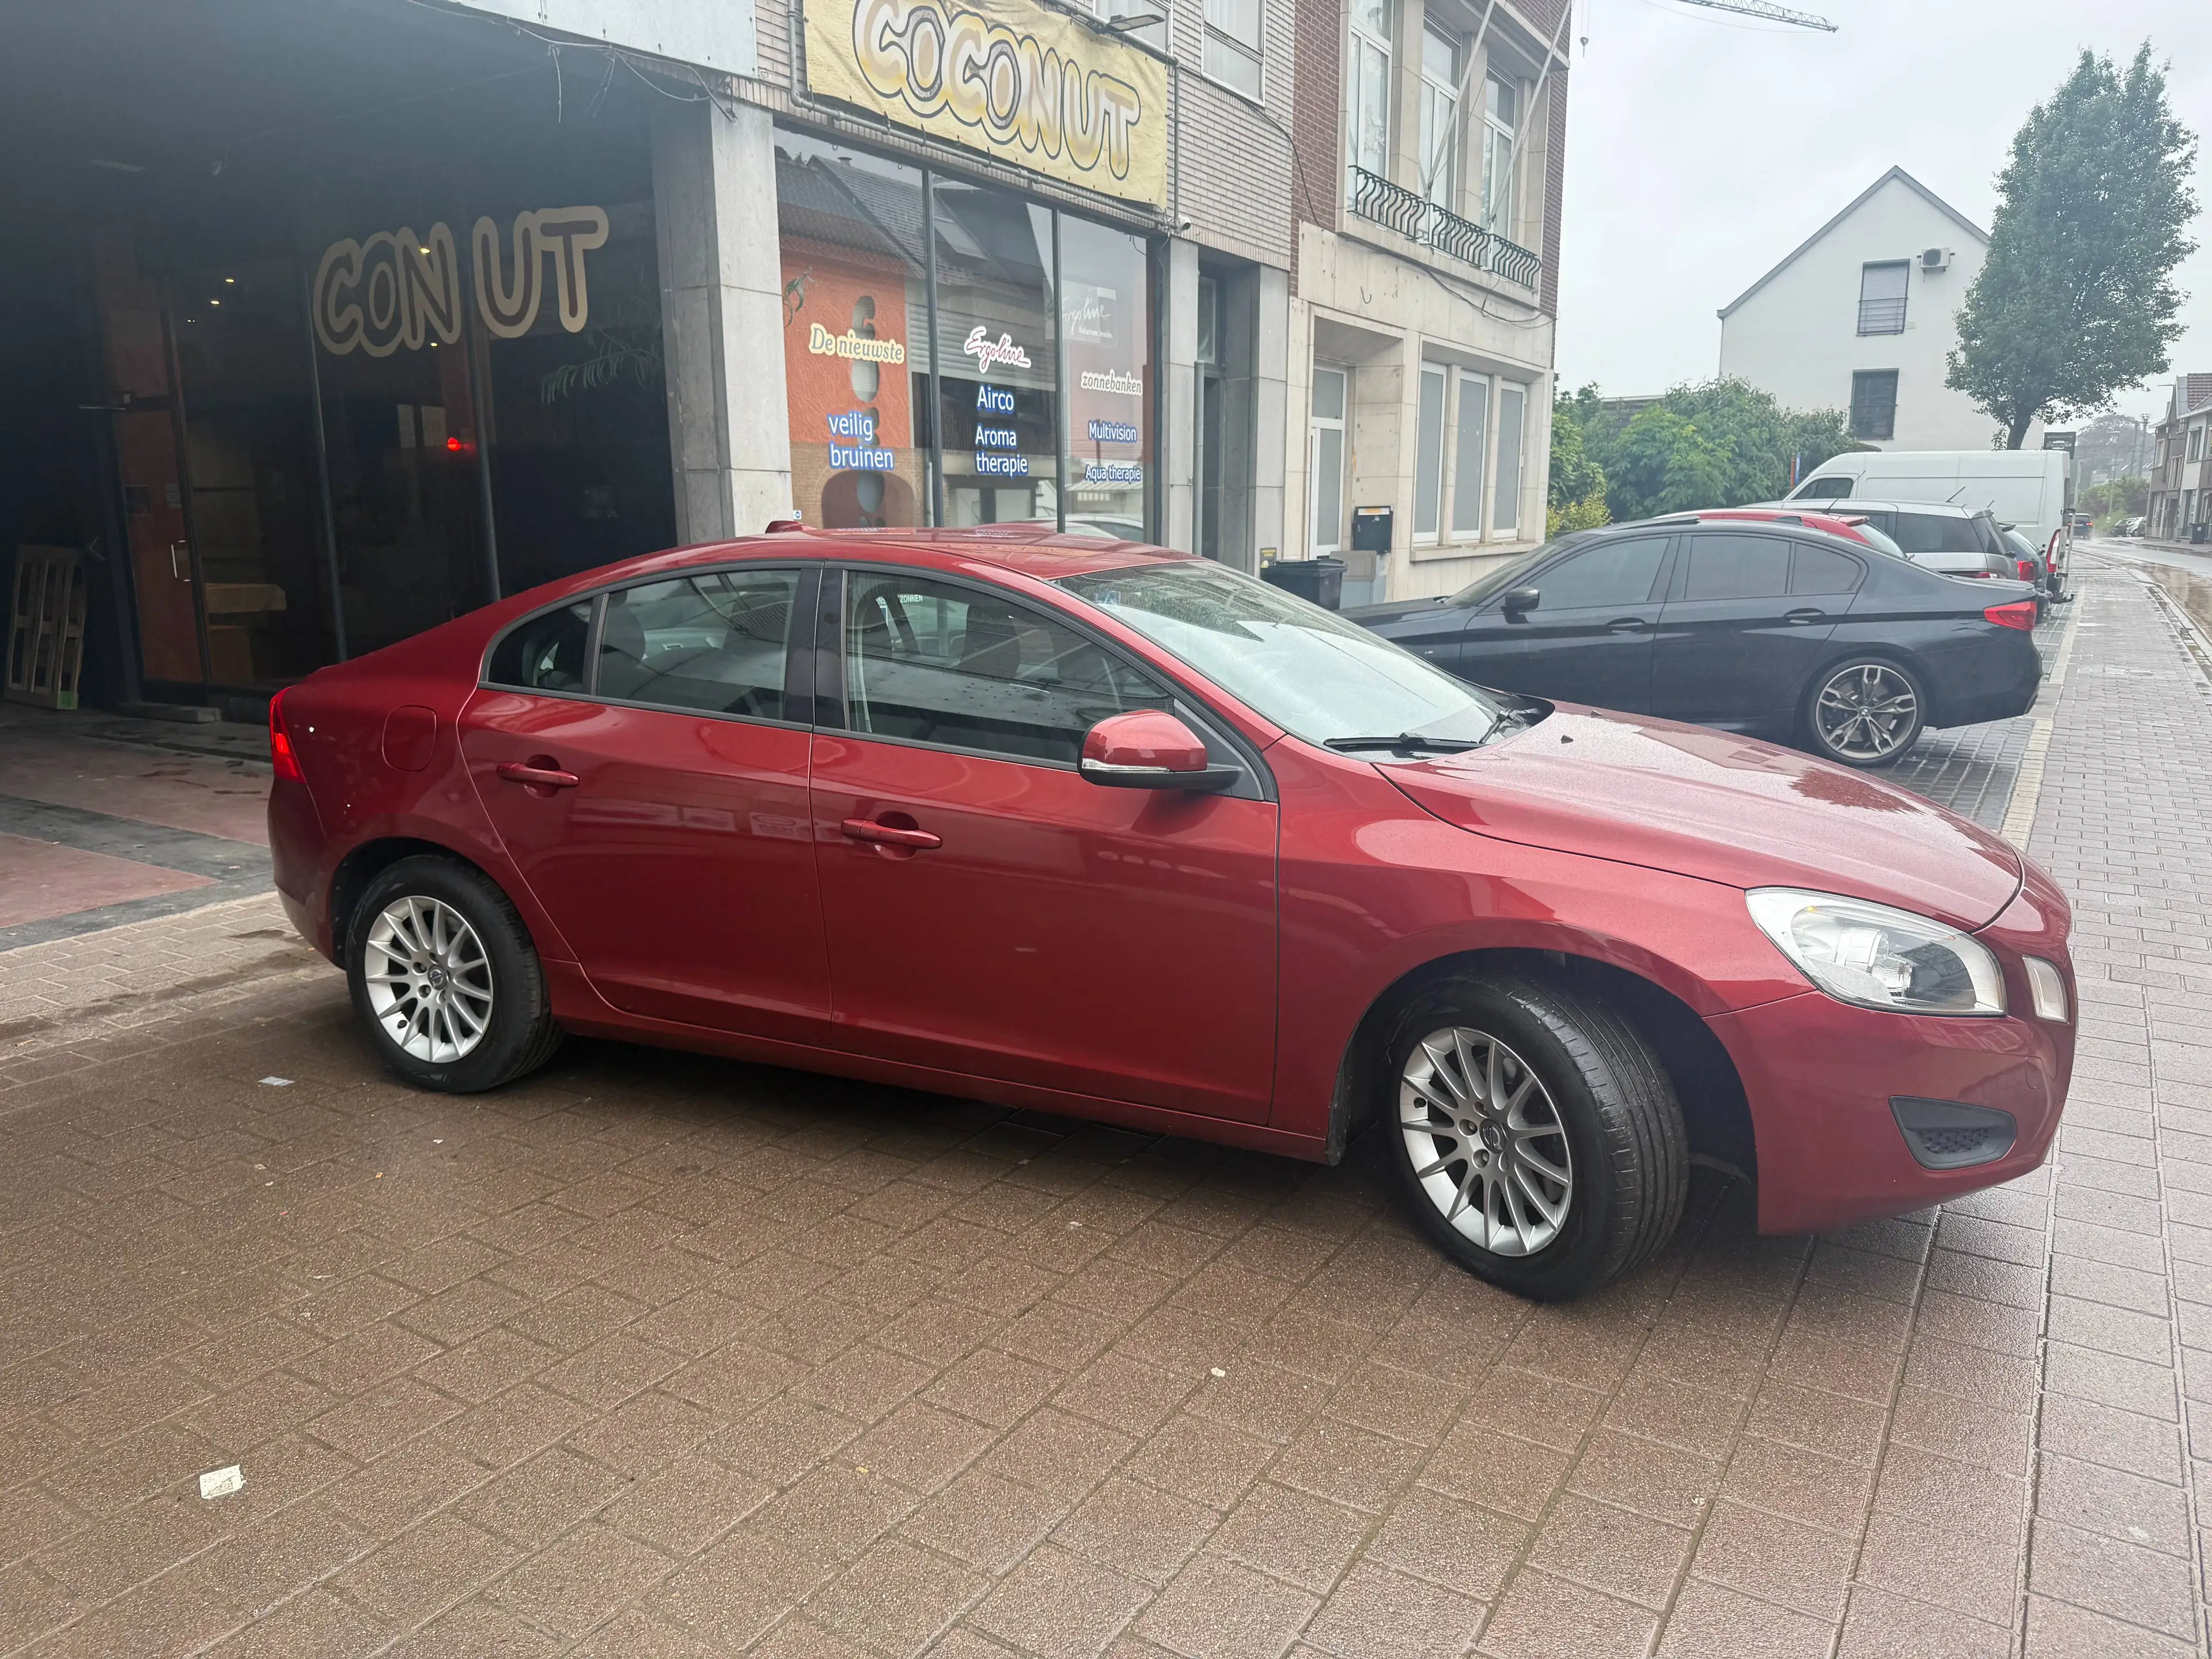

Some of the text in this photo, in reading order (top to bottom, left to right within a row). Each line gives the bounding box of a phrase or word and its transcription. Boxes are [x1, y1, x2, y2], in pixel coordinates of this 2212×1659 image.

[853, 0, 1141, 180] COCONUT
[810, 326, 904, 361] De nieuwste
[967, 330, 1029, 370] Ergoline
[1082, 372, 1142, 394] zonnebanken
[977, 385, 1014, 411] Airco
[828, 412, 873, 441] veilig
[975, 426, 1017, 446] Aroma
[1088, 422, 1137, 441] Multivision
[830, 443, 893, 468] bruinen
[976, 452, 1028, 477] therapie
[1085, 464, 1141, 483] Aqua therapie
